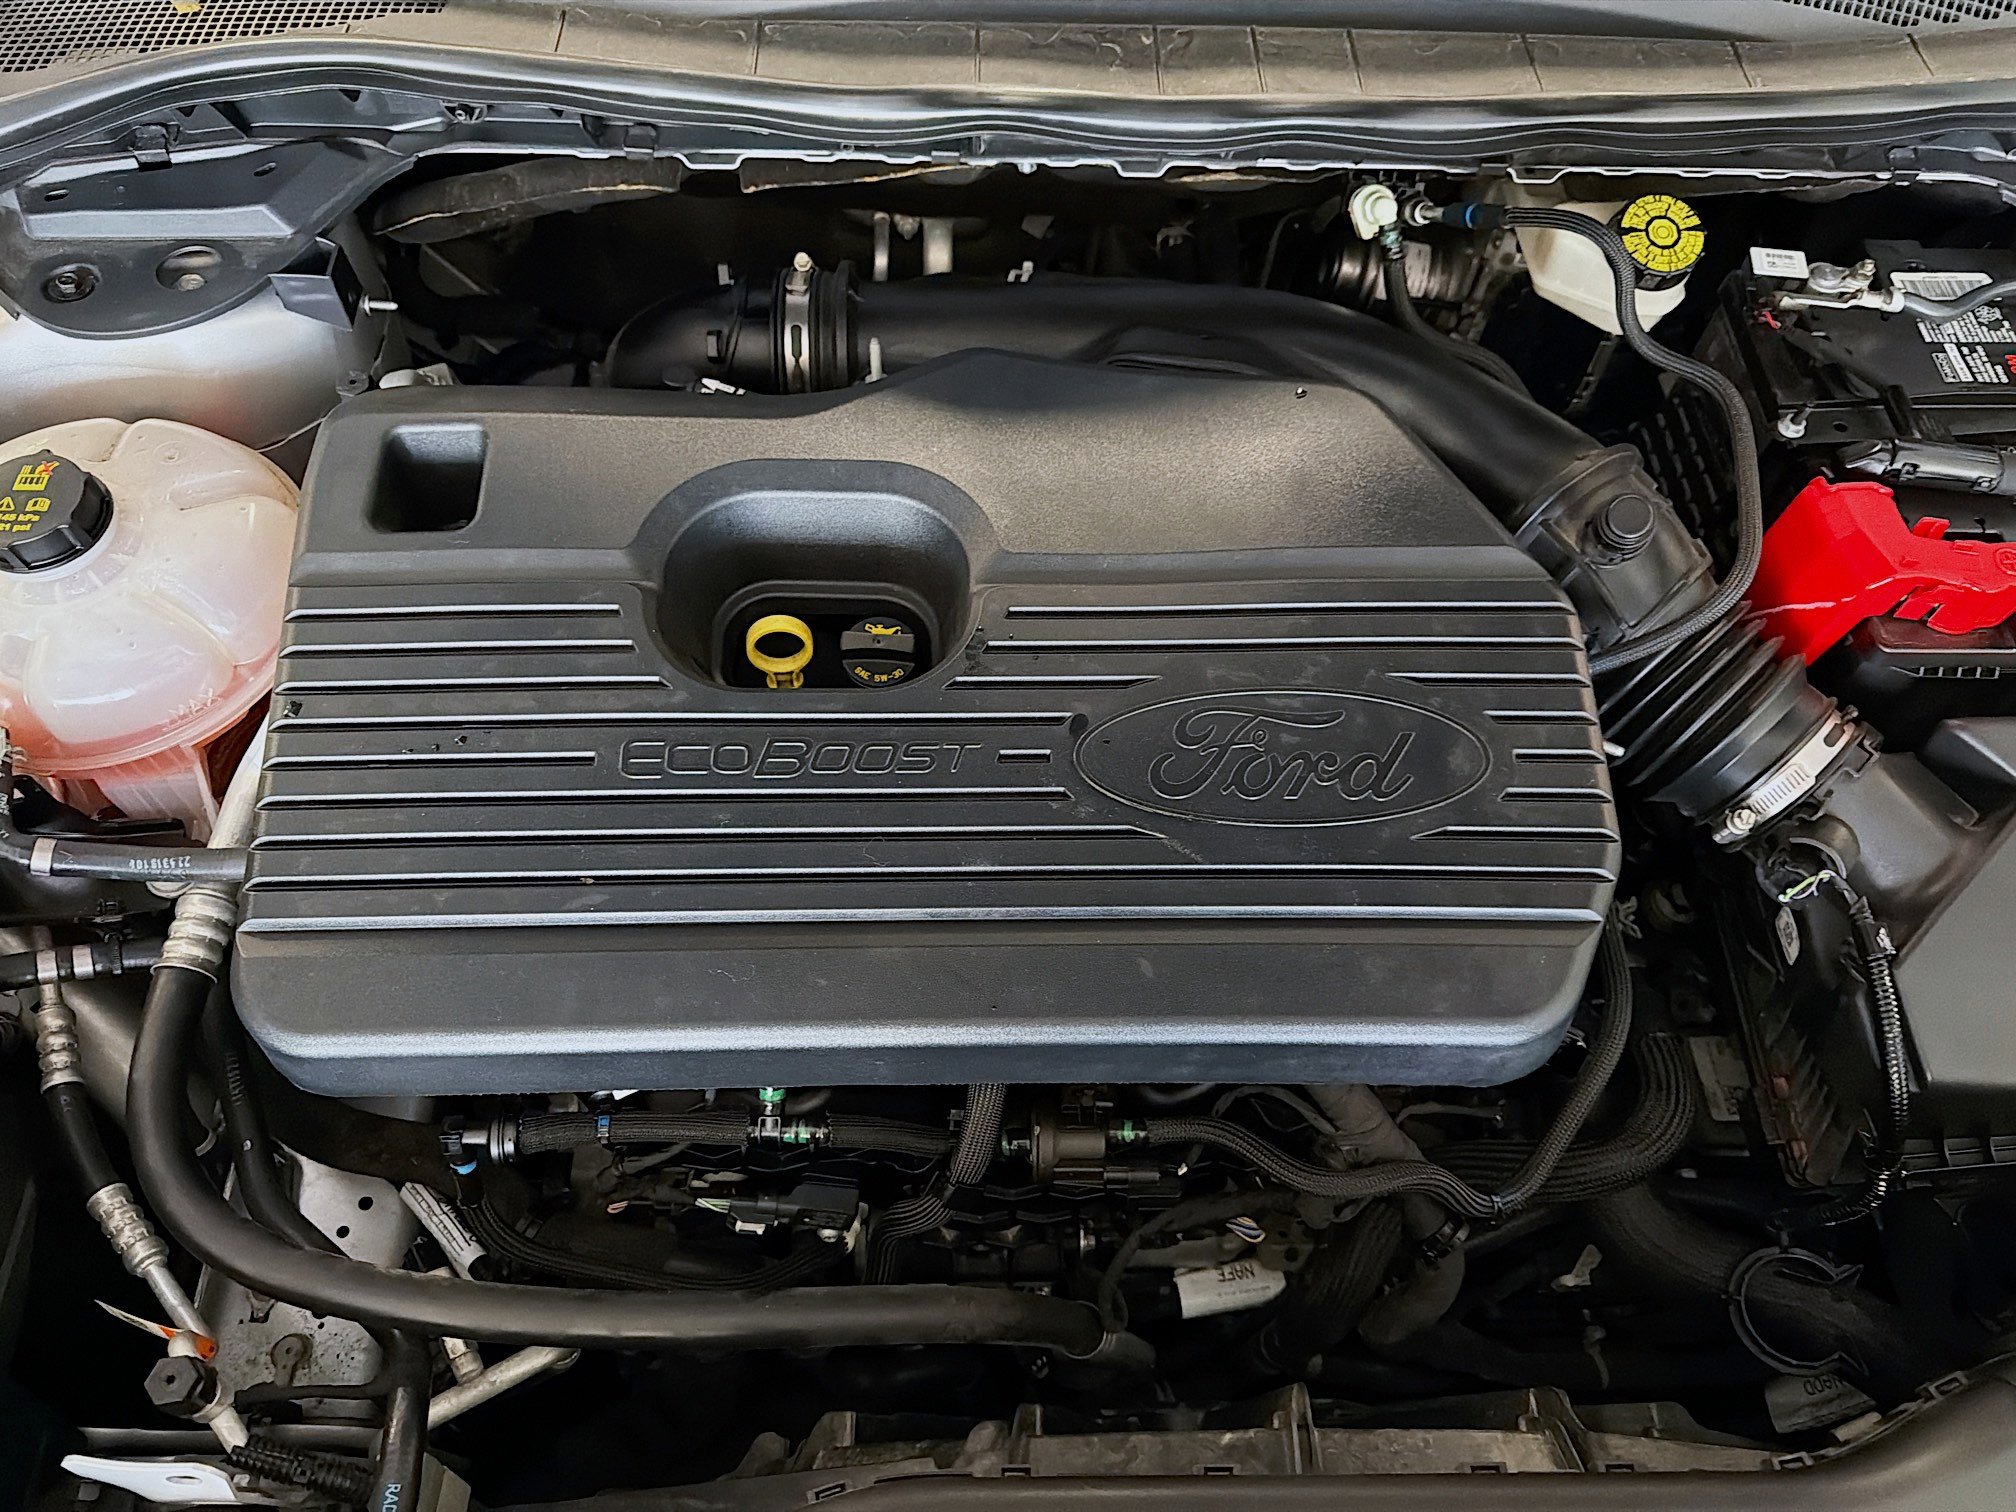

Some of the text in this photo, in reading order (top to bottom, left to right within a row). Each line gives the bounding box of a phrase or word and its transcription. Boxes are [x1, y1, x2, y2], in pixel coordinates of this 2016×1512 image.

[854, 666, 904, 682] SAE 5W-30
[1147, 705, 1416, 802] Ford
